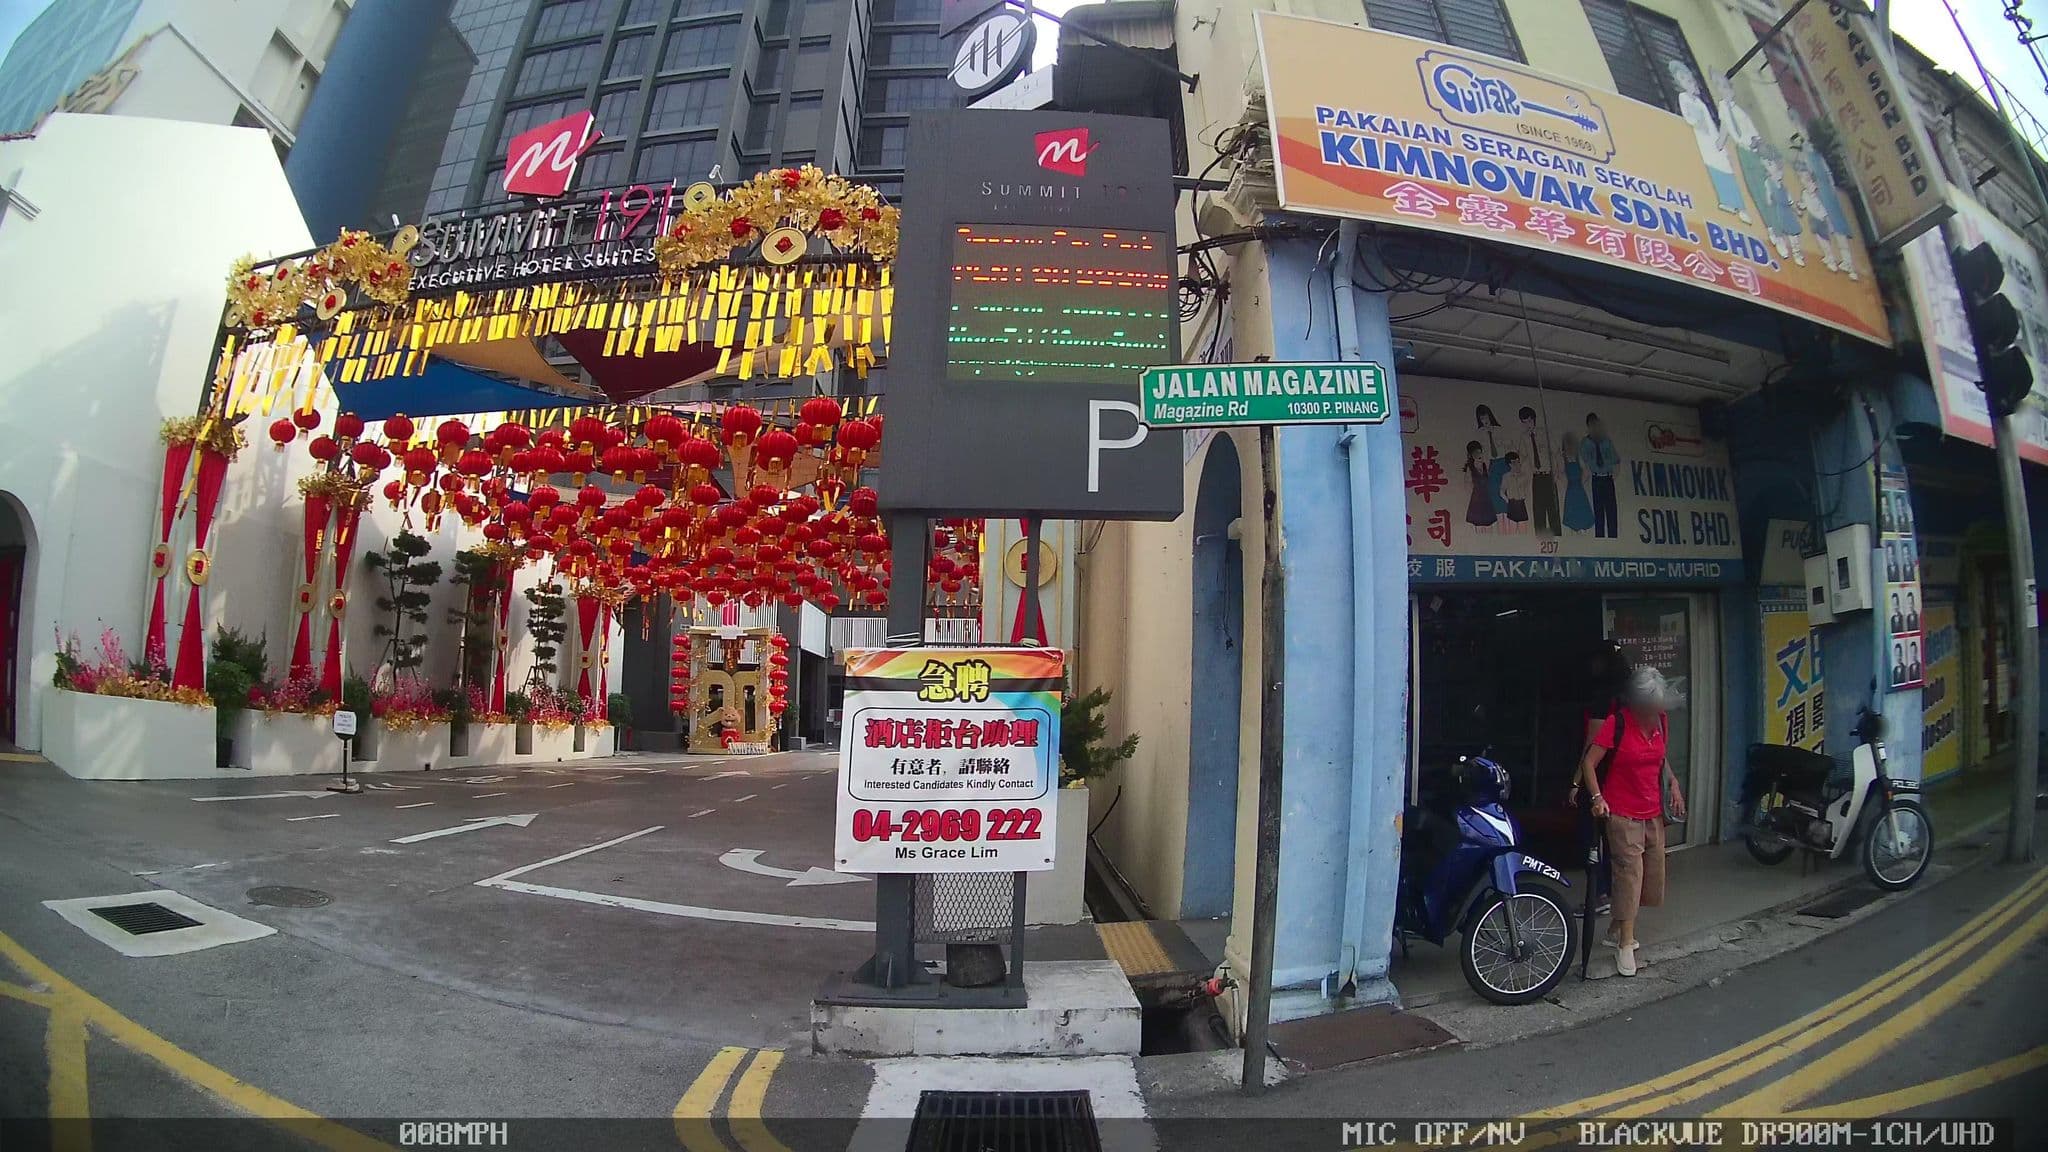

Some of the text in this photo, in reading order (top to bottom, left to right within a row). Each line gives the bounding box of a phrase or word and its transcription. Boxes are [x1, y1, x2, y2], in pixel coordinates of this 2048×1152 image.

[1315, 105, 1693, 210] PAKAIAN SERAGAM SEKOLAH
[1894, 134, 1929, 198] BHD
[982, 181, 1080, 199] SUMMIT
[1319, 130, 1781, 272] KIMNOVAK SDN. BHD.
[410, 184, 674, 267] SUMMIT 191
[407, 246, 657, 292] EXECUTIVE HOTEL SUITES
[1153, 369, 1378, 400] JALAN MAGAZINE
[1154, 400, 1249, 422] Magazine Rd
[1287, 401, 1320, 415] 10300
[1334, 401, 1379, 415] PINANG
[1088, 399, 1149, 493] P
[1631, 459, 1731, 502] KIMNOVAK
[1638, 508, 1737, 547] SDN. BHD.
[1540, 541, 1559, 555] 207
[1595, 562, 1721, 580] MURID-MURID
[917, 659, 992, 701] 急聘
[864, 718, 1040, 749] 酒店柜台助理
[864, 779, 1034, 791] Interested Candidates Kindly Contact
[852, 808, 1043, 842] 04-2969 222
[895, 846, 998, 859] Ms Grace Lim
